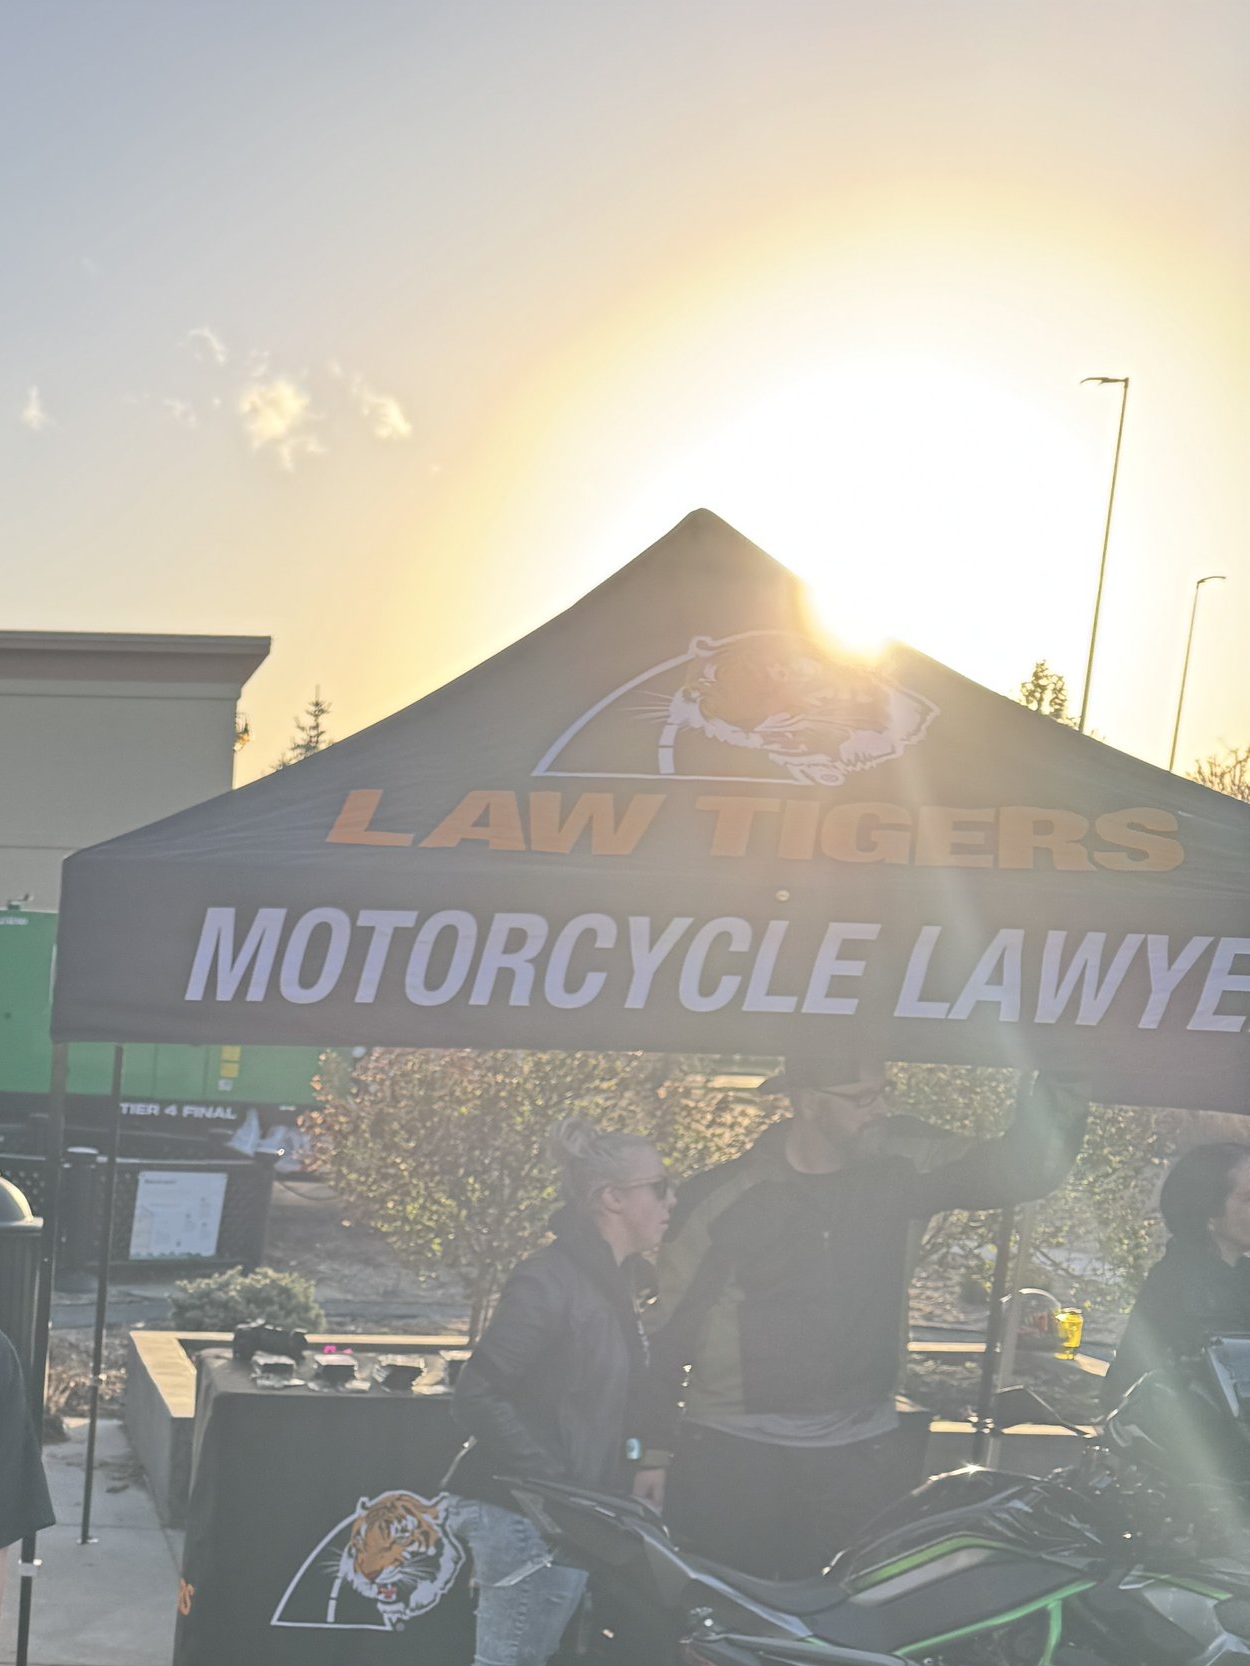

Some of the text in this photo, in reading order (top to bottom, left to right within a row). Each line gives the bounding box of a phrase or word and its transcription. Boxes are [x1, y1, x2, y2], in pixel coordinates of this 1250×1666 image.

[325, 789, 1185, 872] LAW TIGERS
[185, 907, 1250, 1032] MOTORCYCLE LAWYE
[119, 1102, 237, 1120] TIER 4 FINAL
